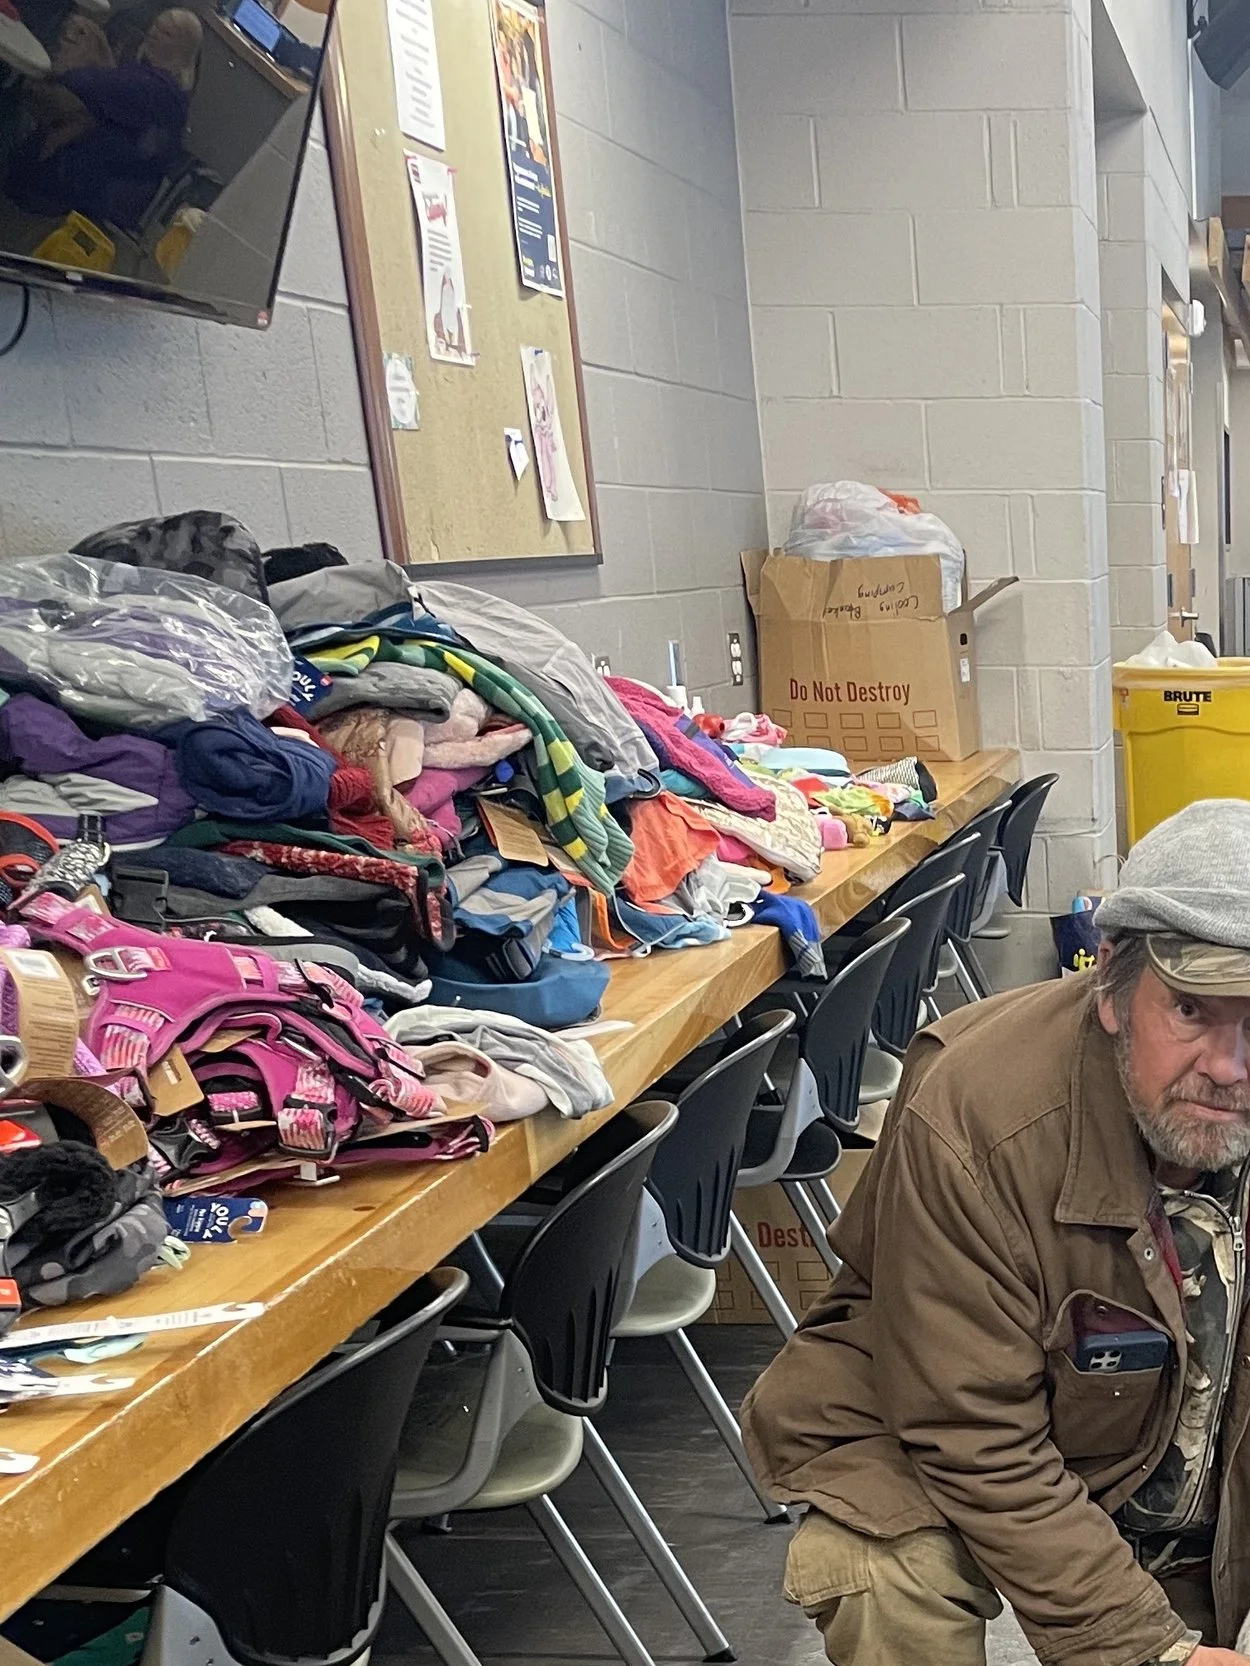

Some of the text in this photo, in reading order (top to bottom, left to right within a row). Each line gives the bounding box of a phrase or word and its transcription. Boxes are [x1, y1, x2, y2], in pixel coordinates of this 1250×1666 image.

[789, 678, 911, 706] Do Not Destroy
[1163, 690, 1212, 702] BRUTE
[202, 1202, 230, 1240] YOULY
